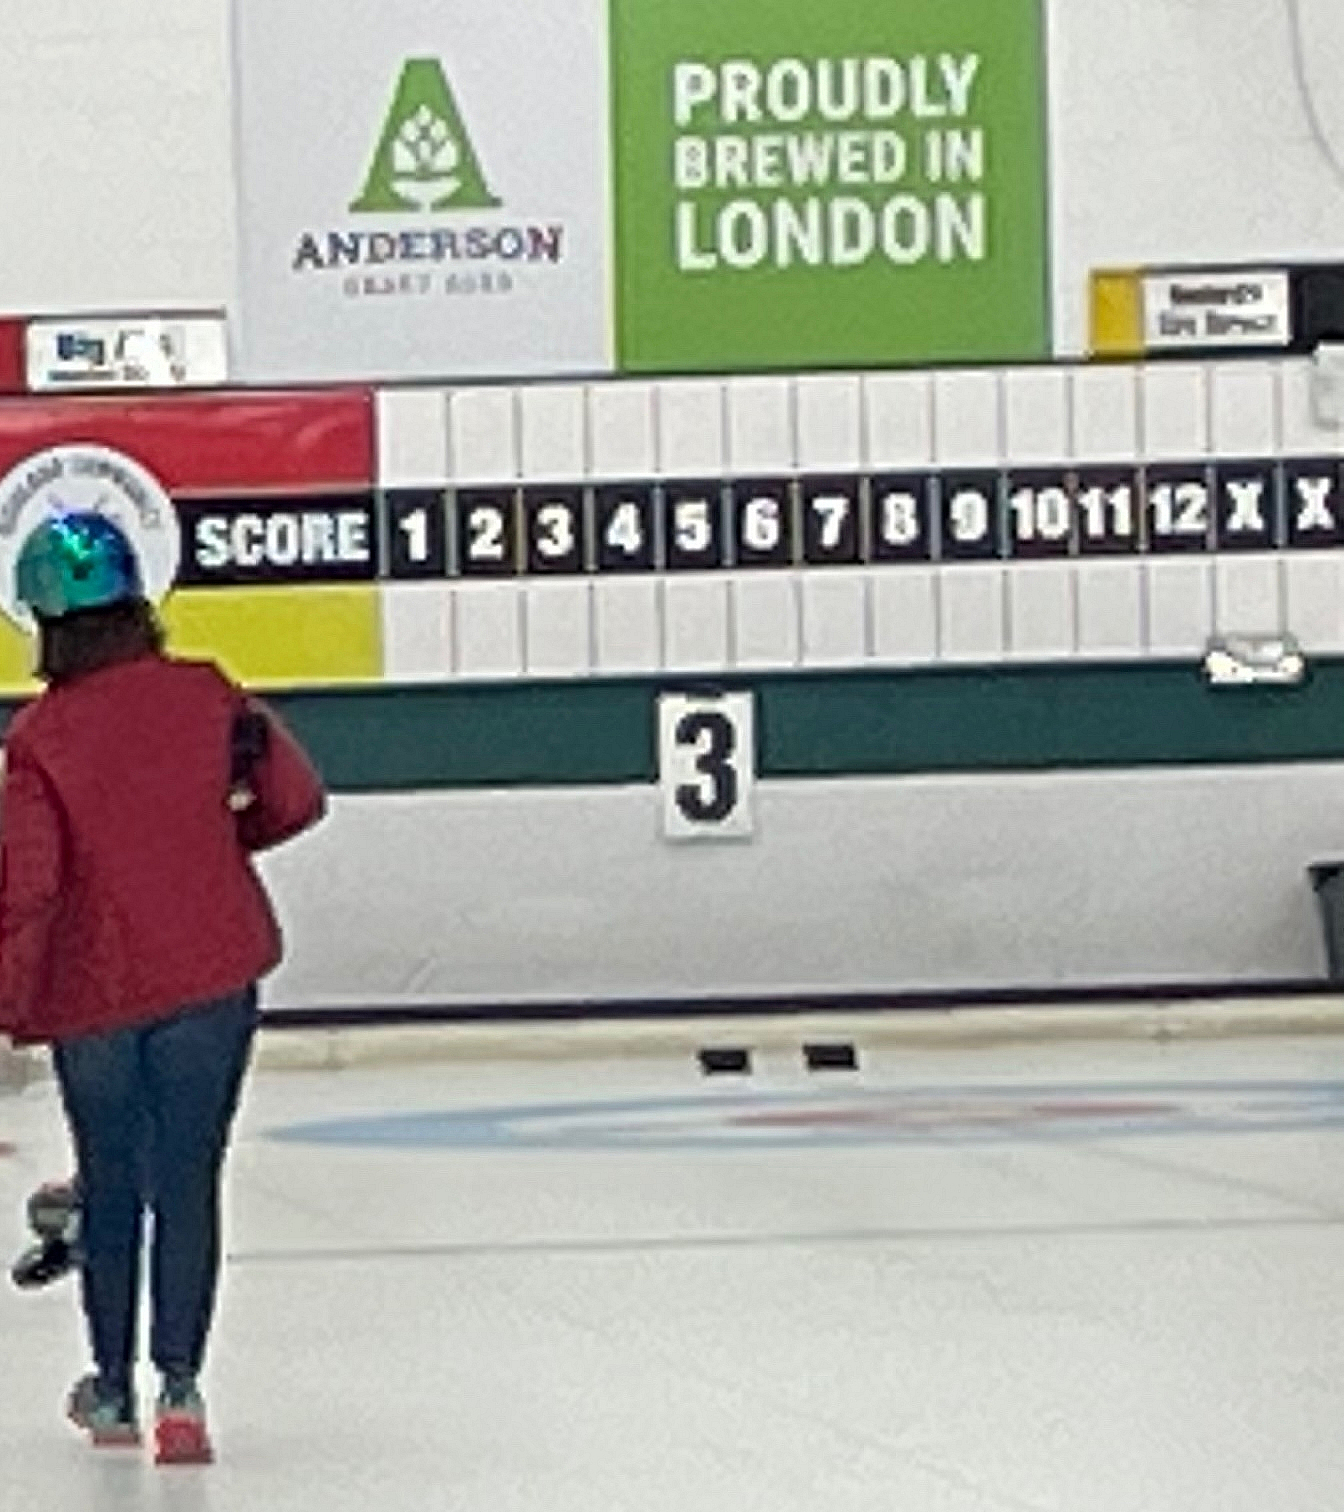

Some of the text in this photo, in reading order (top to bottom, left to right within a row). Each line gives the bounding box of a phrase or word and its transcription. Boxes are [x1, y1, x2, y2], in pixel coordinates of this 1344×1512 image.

[674, 53, 979, 126] PROUDLY
[675, 129, 983, 189] BREWED IN
[292, 228, 563, 270] ANDERSON
[677, 193, 984, 270] LONDON
[196, 477, 1334, 567] SCORE 1 2 3 4 5 6 7 8 9 10 11 12 X X
[674, 712, 736, 824] 3
